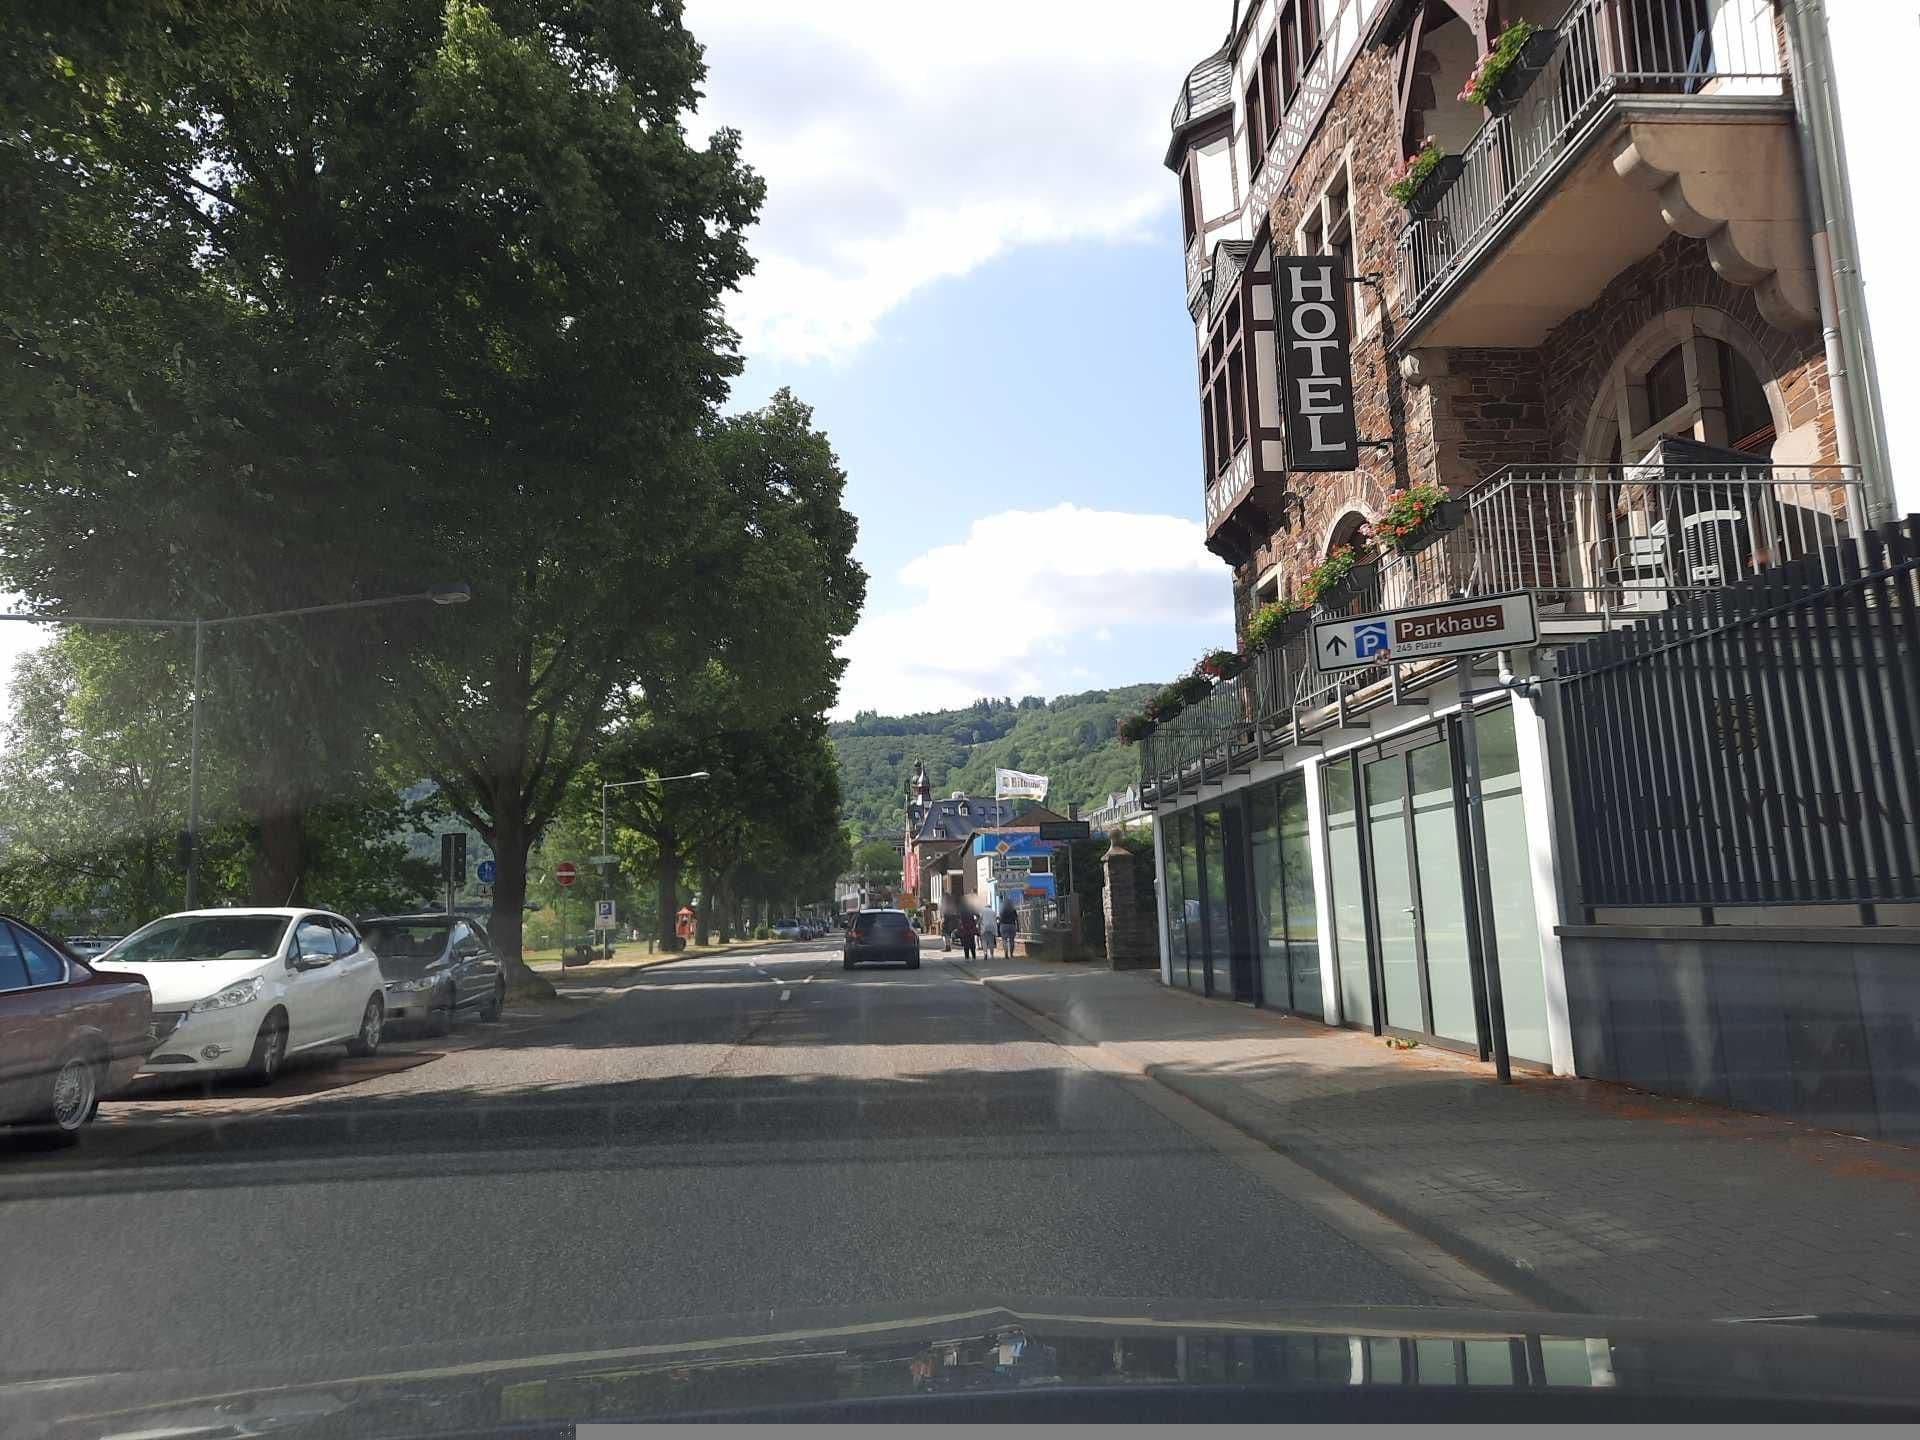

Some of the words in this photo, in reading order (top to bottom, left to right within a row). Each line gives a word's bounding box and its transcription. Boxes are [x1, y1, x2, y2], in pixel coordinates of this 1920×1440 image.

[1288, 266, 1346, 451] HOTEL
[1400, 613, 1497, 639] Parkhaus
[1363, 635, 1378, 655] P
[1415, 641, 1442, 650] Plätze
